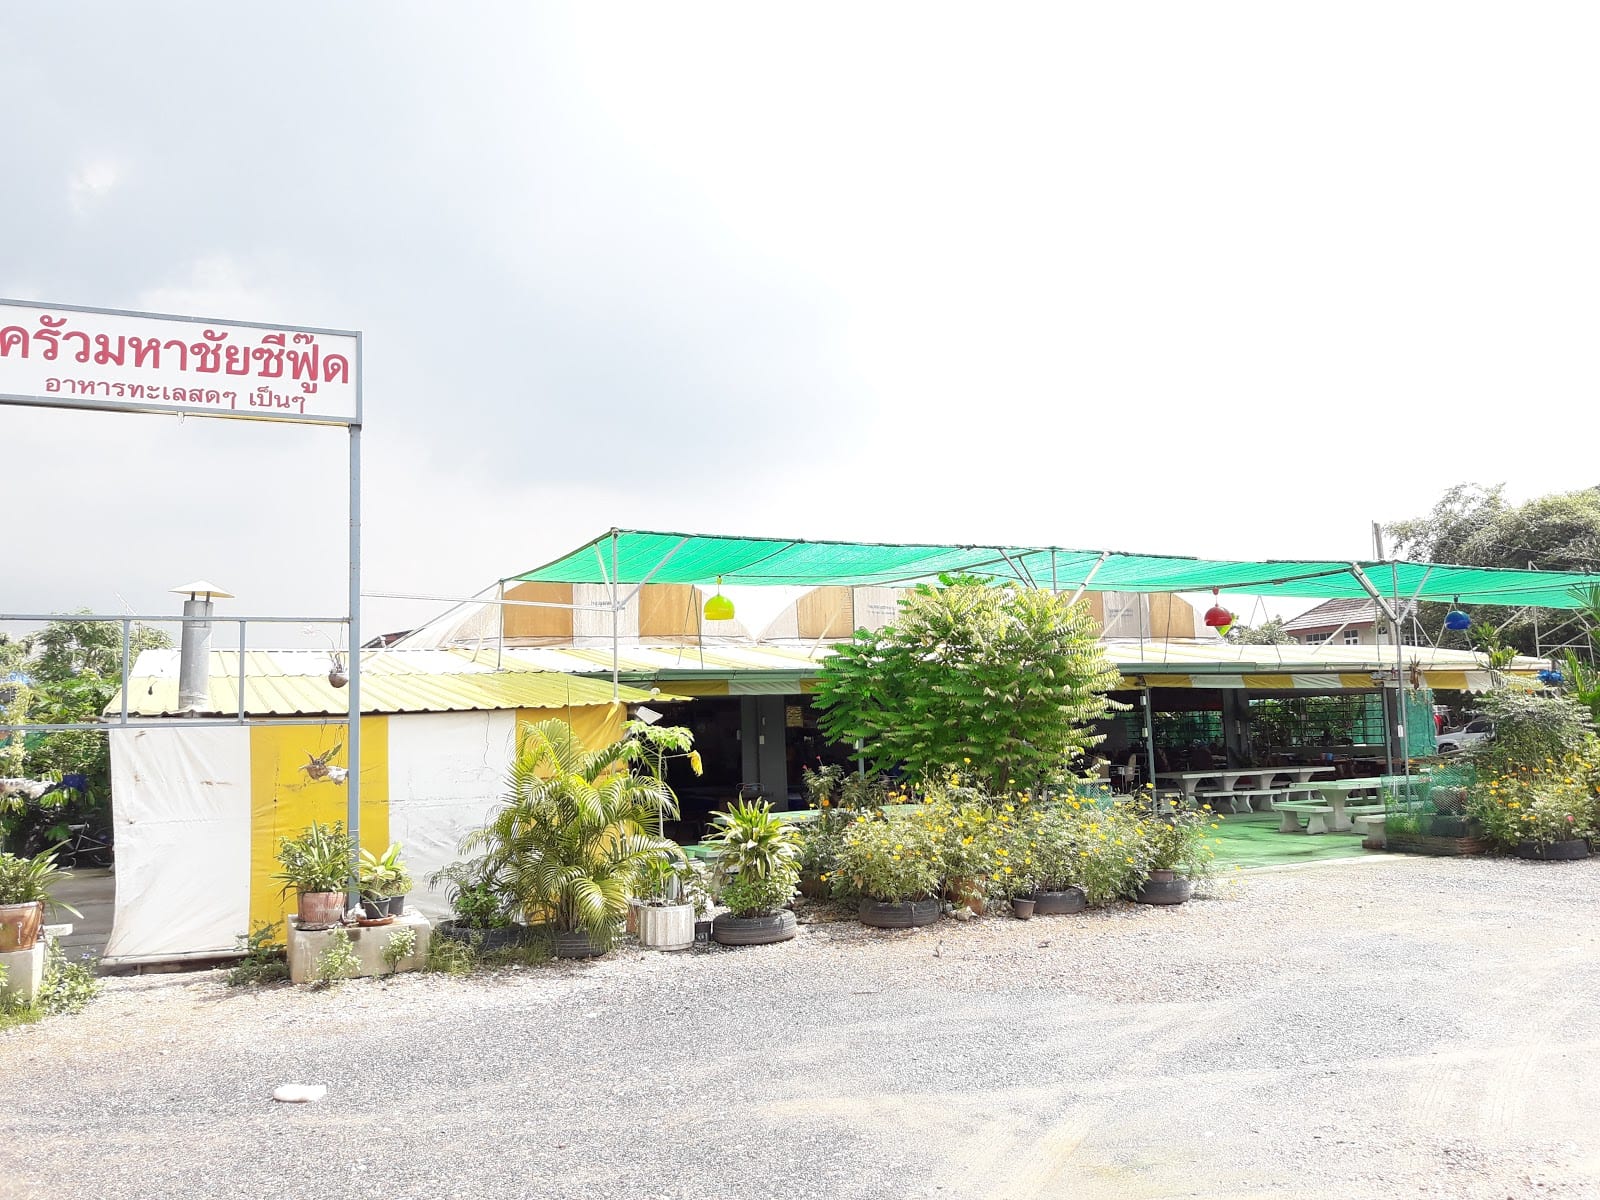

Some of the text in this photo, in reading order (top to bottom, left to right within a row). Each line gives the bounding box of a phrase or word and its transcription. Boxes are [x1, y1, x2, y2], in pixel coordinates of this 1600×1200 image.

[0, 314, 349, 393] ครัวมหาชัยซีฟู๊ด
[45, 378, 306, 414] อาหารทะเลสดๆ เป็นๆ
